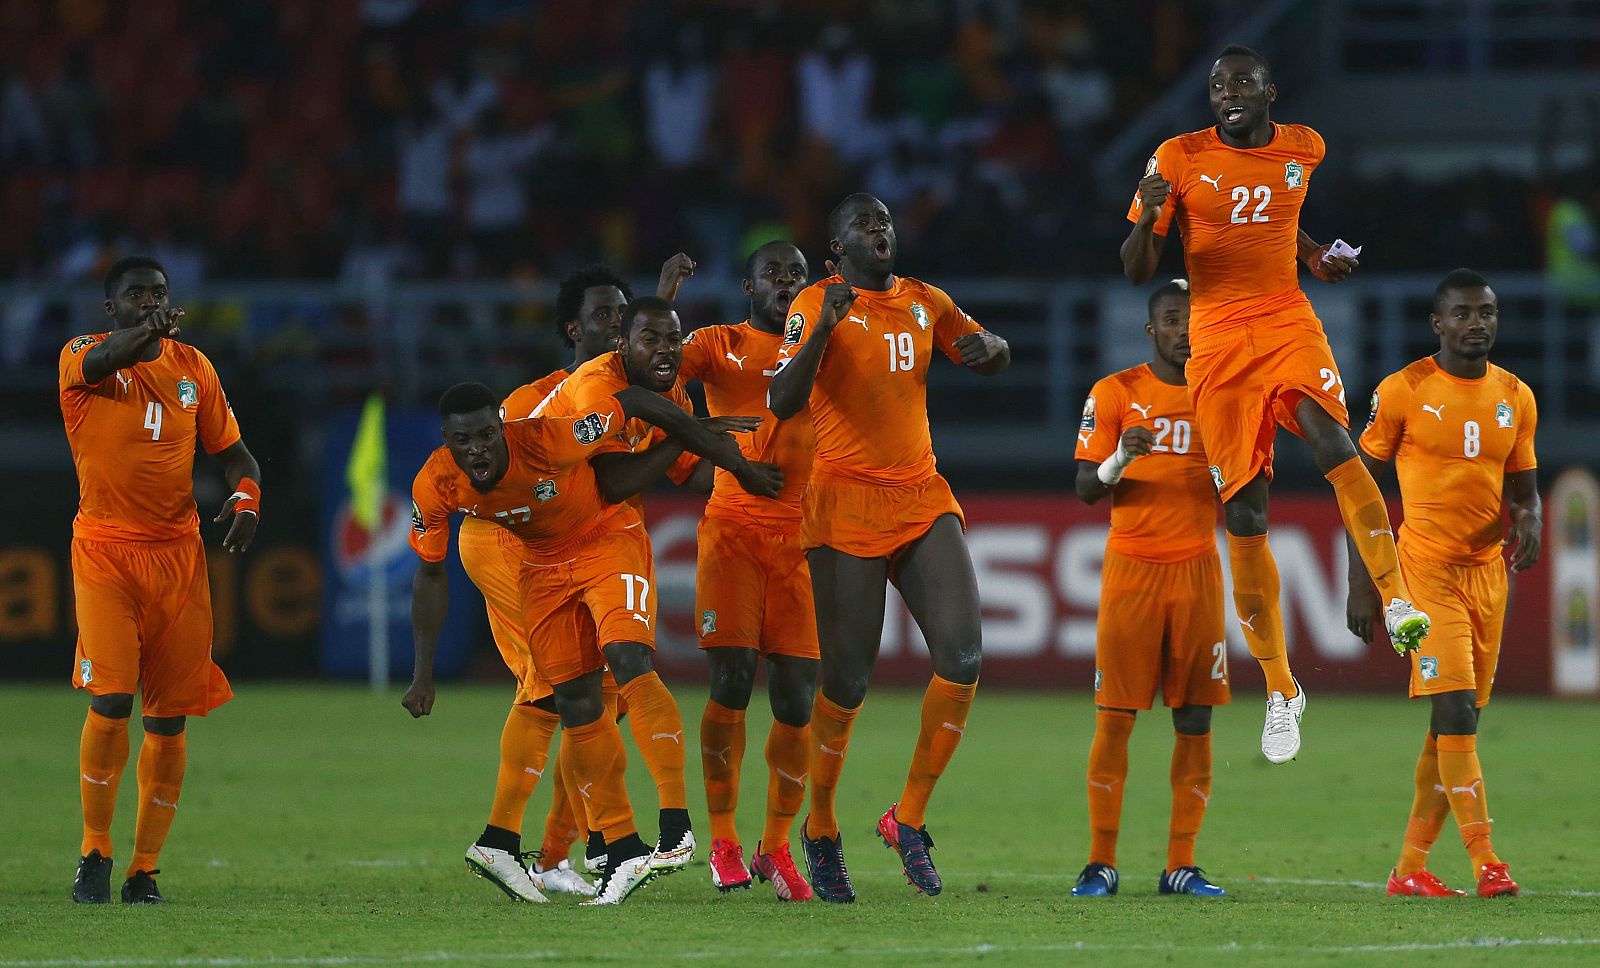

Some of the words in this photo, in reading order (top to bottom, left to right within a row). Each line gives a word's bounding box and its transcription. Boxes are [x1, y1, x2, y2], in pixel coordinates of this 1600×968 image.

[1231, 185, 1271, 224] 22
[883, 332, 915, 372] 19
[144, 401, 163, 441] 4
[1151, 417, 1191, 455] 20
[1464, 420, 1480, 458] 8
[620, 573, 649, 612] 17
